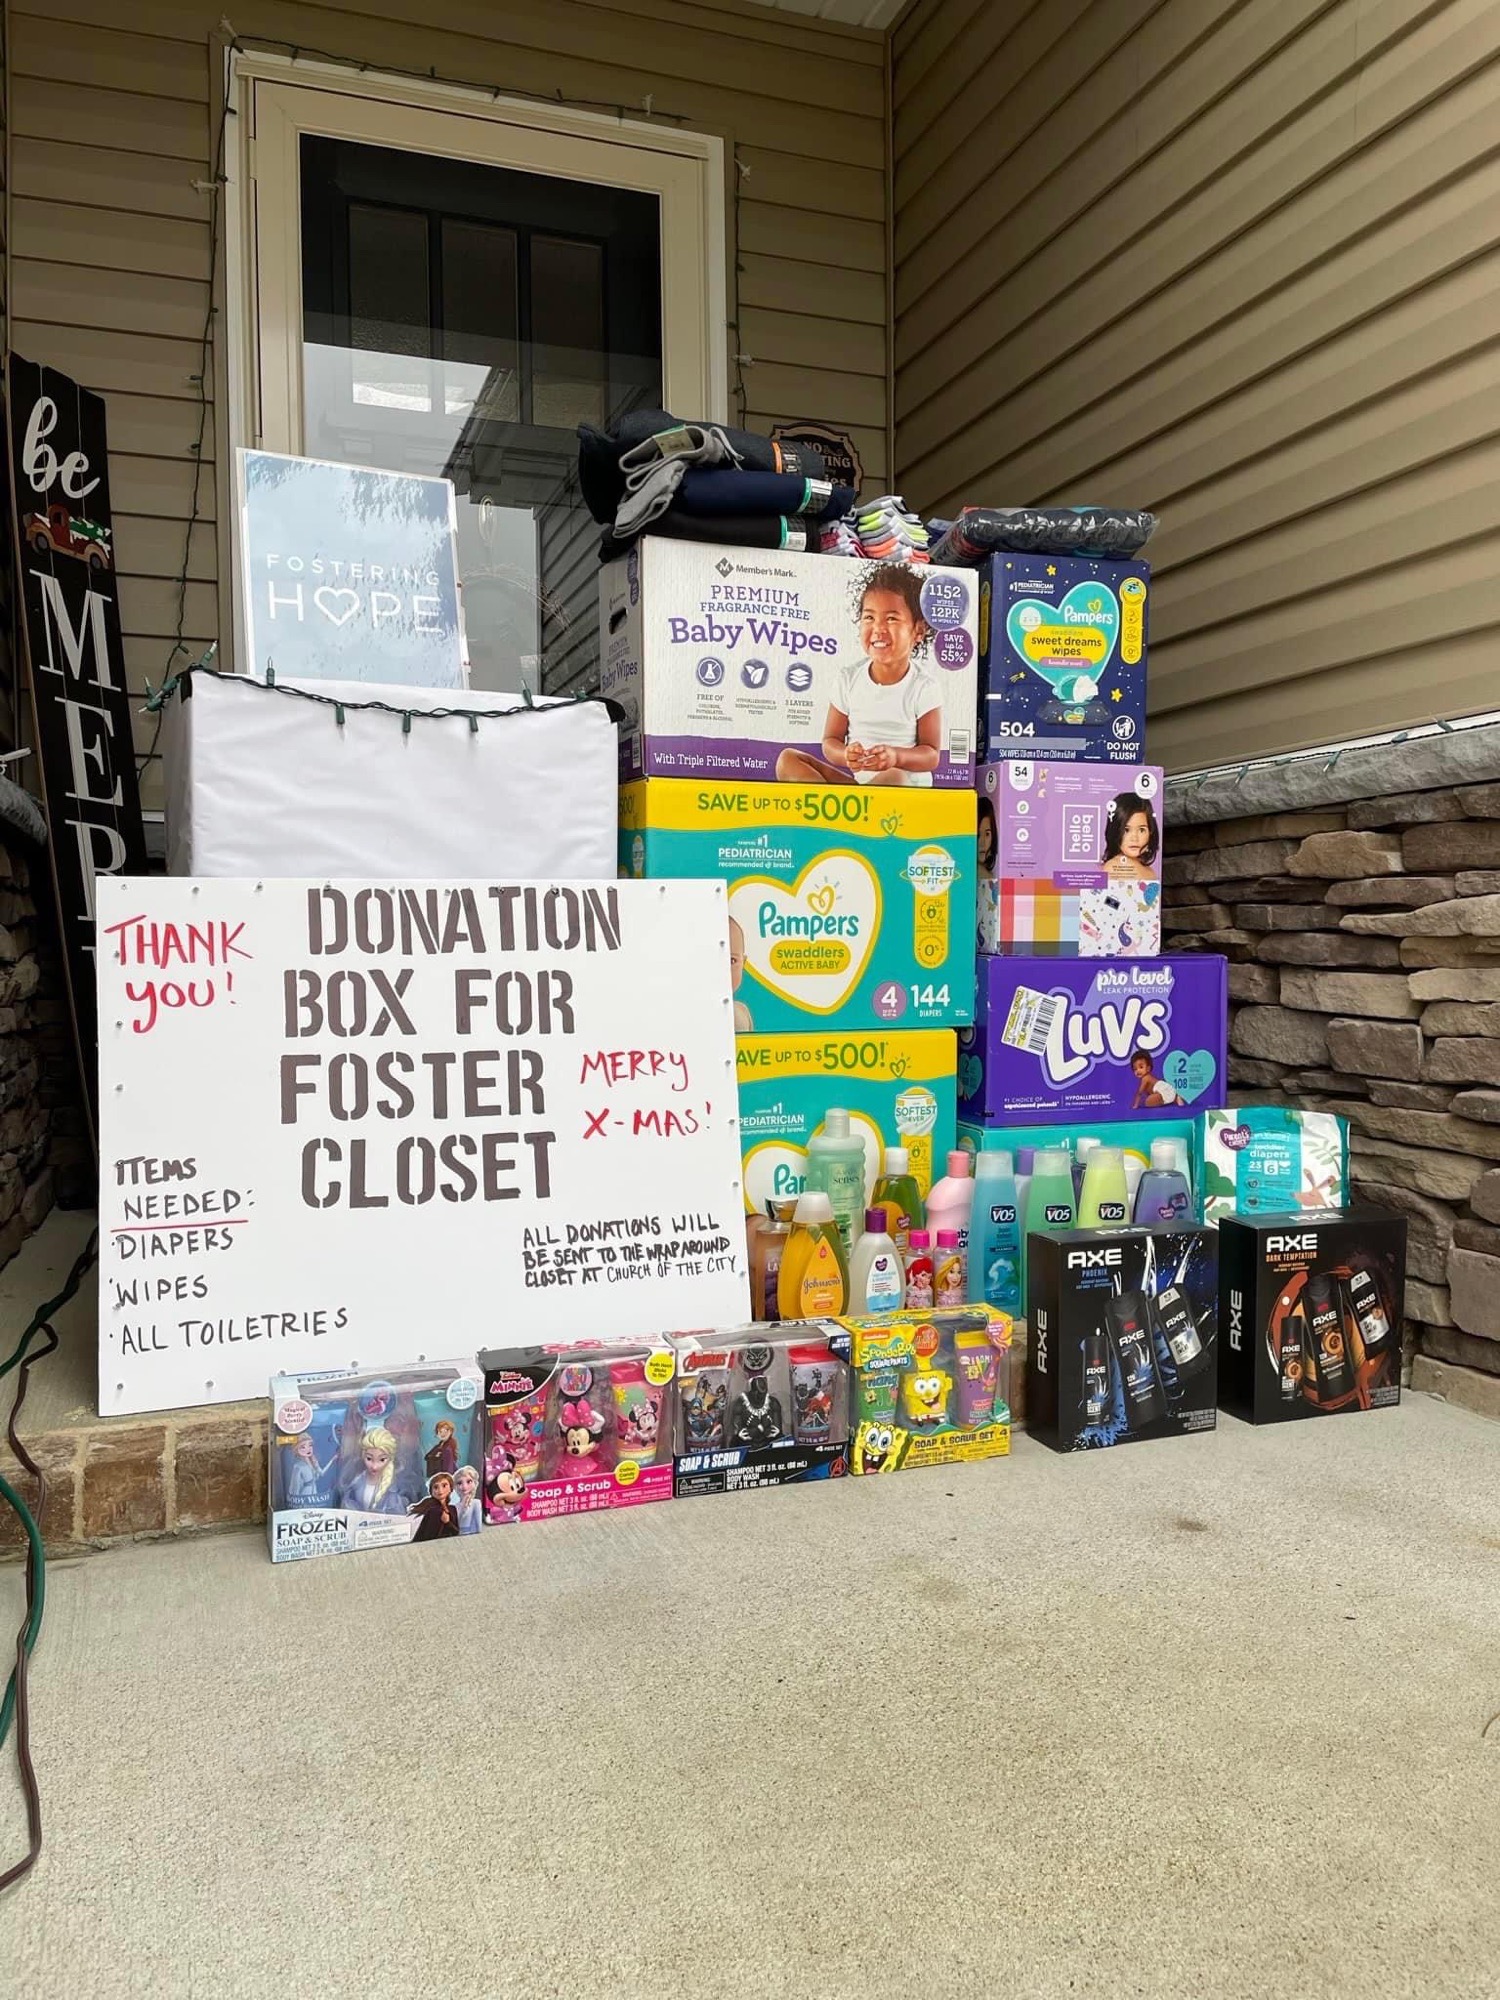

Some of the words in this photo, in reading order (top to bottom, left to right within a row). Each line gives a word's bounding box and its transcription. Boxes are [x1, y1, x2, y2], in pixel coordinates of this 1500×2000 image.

[22, 396, 100, 498] be
[266, 553, 441, 587] FOSTERING
[736, 564, 773, 576] Member's
[774, 568, 794, 578] Mark
[711, 585, 799, 606] PREMIUM
[929, 584, 961, 599] 1152
[700, 602, 778, 616] FRAGRANCE
[780, 607, 811, 621] FREE
[931, 607, 960, 619] 12PK
[1063, 604, 1114, 626] Pampers
[668, 614, 743, 648] Baby
[746, 617, 838, 655] Wipes
[943, 633, 964, 643] SAVE
[1031, 636, 1062, 646] sweet
[1064, 637, 1102, 648] dreams
[945, 643, 954, 652] up
[955, 642, 963, 650] to
[1051, 646, 1082, 657] wipes
[999, 721, 1036, 737] 504
[29, 569, 127, 935] MER
[1106, 742, 1121, 751] DO
[1121, 742, 1140, 751] NOT
[653, 752, 675, 766] With
[677, 754, 704, 769] Triple
[705, 755, 742, 769] Filtered
[743, 757, 768, 770] Water
[1110, 751, 1136, 760] FLUSH
[1014, 766, 1028, 777] 54
[1140, 774, 1150, 788] 6
[697, 793, 748, 812] SAVE
[753, 797, 770, 810] UP
[773, 798, 791, 811] TO
[1069, 814, 1081, 853] hello
[1082, 814, 1094, 853] bello
[718, 848, 792, 859] PEDIATRICIAN
[908, 866, 954, 877] SOFTEST
[926, 877, 940, 885] FIT
[307, 886, 622, 955] DONATION
[758, 901, 860, 941] Pampers
[103, 915, 254, 969] THANK
[776, 944, 845, 959] swaddlers
[780, 960, 815, 971] ACTIVE
[815, 960, 841, 971] BABY
[1097, 968, 1127, 992] pro
[1132, 965, 1174, 986] level
[881, 985, 898, 1008] 4
[910, 984, 951, 1008] 144
[1103, 986, 1122, 995] LEAK
[1123, 986, 1169, 995] PROTECTION
[284, 968, 417, 1038] BOX
[455, 968, 576, 1035] FOR
[919, 1009, 942, 1018] DIAPERS
[736, 1049, 771, 1066] AVE
[775, 1053, 793, 1063] UP
[795, 1051, 811, 1061] TO
[1178, 1057, 1187, 1074] 2
[580, 1050, 690, 1092] MERRY
[280, 1049, 546, 1125] FOSTER
[1174, 1078, 1188, 1089] 108
[1065, 1093, 1111, 1101] HYPOALLERGENIC
[895, 1104, 938, 1117] SOFTEST
[739, 1114, 805, 1127] PEDIATRICIAN
[1249, 1149, 1290, 1159] diapers
[114, 1156, 197, 1186] ITEMS
[301, 1131, 557, 1209] CLOSET
[1267, 1164, 1275, 1174] 6
[123, 1189, 255, 1221] NEEDED:
[1099, 1206, 1124, 1220] VO5
[992, 1207, 1015, 1222] VO5
[1046, 1208, 1070, 1222] VO5
[523, 1226, 560, 1249] ALL
[566, 1216, 662, 1245] DONATIONS
[672, 1213, 720, 1233] WILL
[116, 1228, 234, 1260] DIAPERS
[1266, 1233, 1318, 1253] AXE
[522, 1249, 550, 1270] BE
[553, 1247, 594, 1267] SENT
[597, 1247, 617, 1264] TO
[619, 1243, 645, 1261] THE
[1067, 1248, 1122, 1269] AXE
[1265, 1253, 1281, 1263] DARK
[1283, 1251, 1318, 1262] TEMPTATION
[525, 1268, 577, 1288] CLOSET
[582, 1267, 603, 1284] AT
[607, 1264, 651, 1283] CHURCH
[657, 1262, 673, 1278] OF
[676, 1262, 703, 1277] THE
[707, 1255, 736, 1274] CITY
[1081, 1268, 1108, 1278] PHOENIX
[116, 1275, 209, 1307] WIPES
[803, 1276, 841, 1294] Johnson's
[1356, 1293, 1376, 1309] AXE
[1165, 1310, 1187, 1328] AXE
[1230, 1289, 1243, 1351] AXE
[1312, 1311, 1337, 1326] AXE
[122, 1324, 169, 1355] ALL
[178, 1307, 348, 1348] TOILETRIES
[1119, 1329, 1145, 1347] AXE
[1037, 1308, 1048, 1373] AXE
[1281, 1344, 1300, 1354] AXE
[869, 1356, 909, 1369] SQUAREPANTS
[1086, 1366, 1106, 1376] AXE
[490, 1377, 534, 1394] MINNIE
[914, 1438, 937, 1448] SOAP
[940, 1437, 946, 1445] &
[949, 1433, 977, 1444] SCRUB
[979, 1430, 994, 1439] SET
[1000, 1428, 1008, 1436] 4
[678, 1458, 701, 1473] SOAP
[703, 1457, 710, 1469] &
[711, 1451, 741, 1468] SCRUB
[726, 1467, 755, 1477] SHAMPOO
[755, 1464, 766, 1473] NET
[777, 1463, 786, 1471] oz.
[726, 1474, 742, 1483] BODY
[743, 1473, 760, 1481] WASH
[726, 1481, 738, 1490] NET
[750, 1480, 758, 1488] oz.
[530, 1487, 562, 1500] Soap
[565, 1484, 574, 1495] &
[577, 1480, 611, 1493] Scrub
[531, 1499, 558, 1510] SHAMPOO
[302, 1511, 324, 1520] Disney
[276, 1515, 348, 1540] FROZEN
[276, 1538, 303, 1548] SOAP
[314, 1532, 347, 1543] SCRUB
